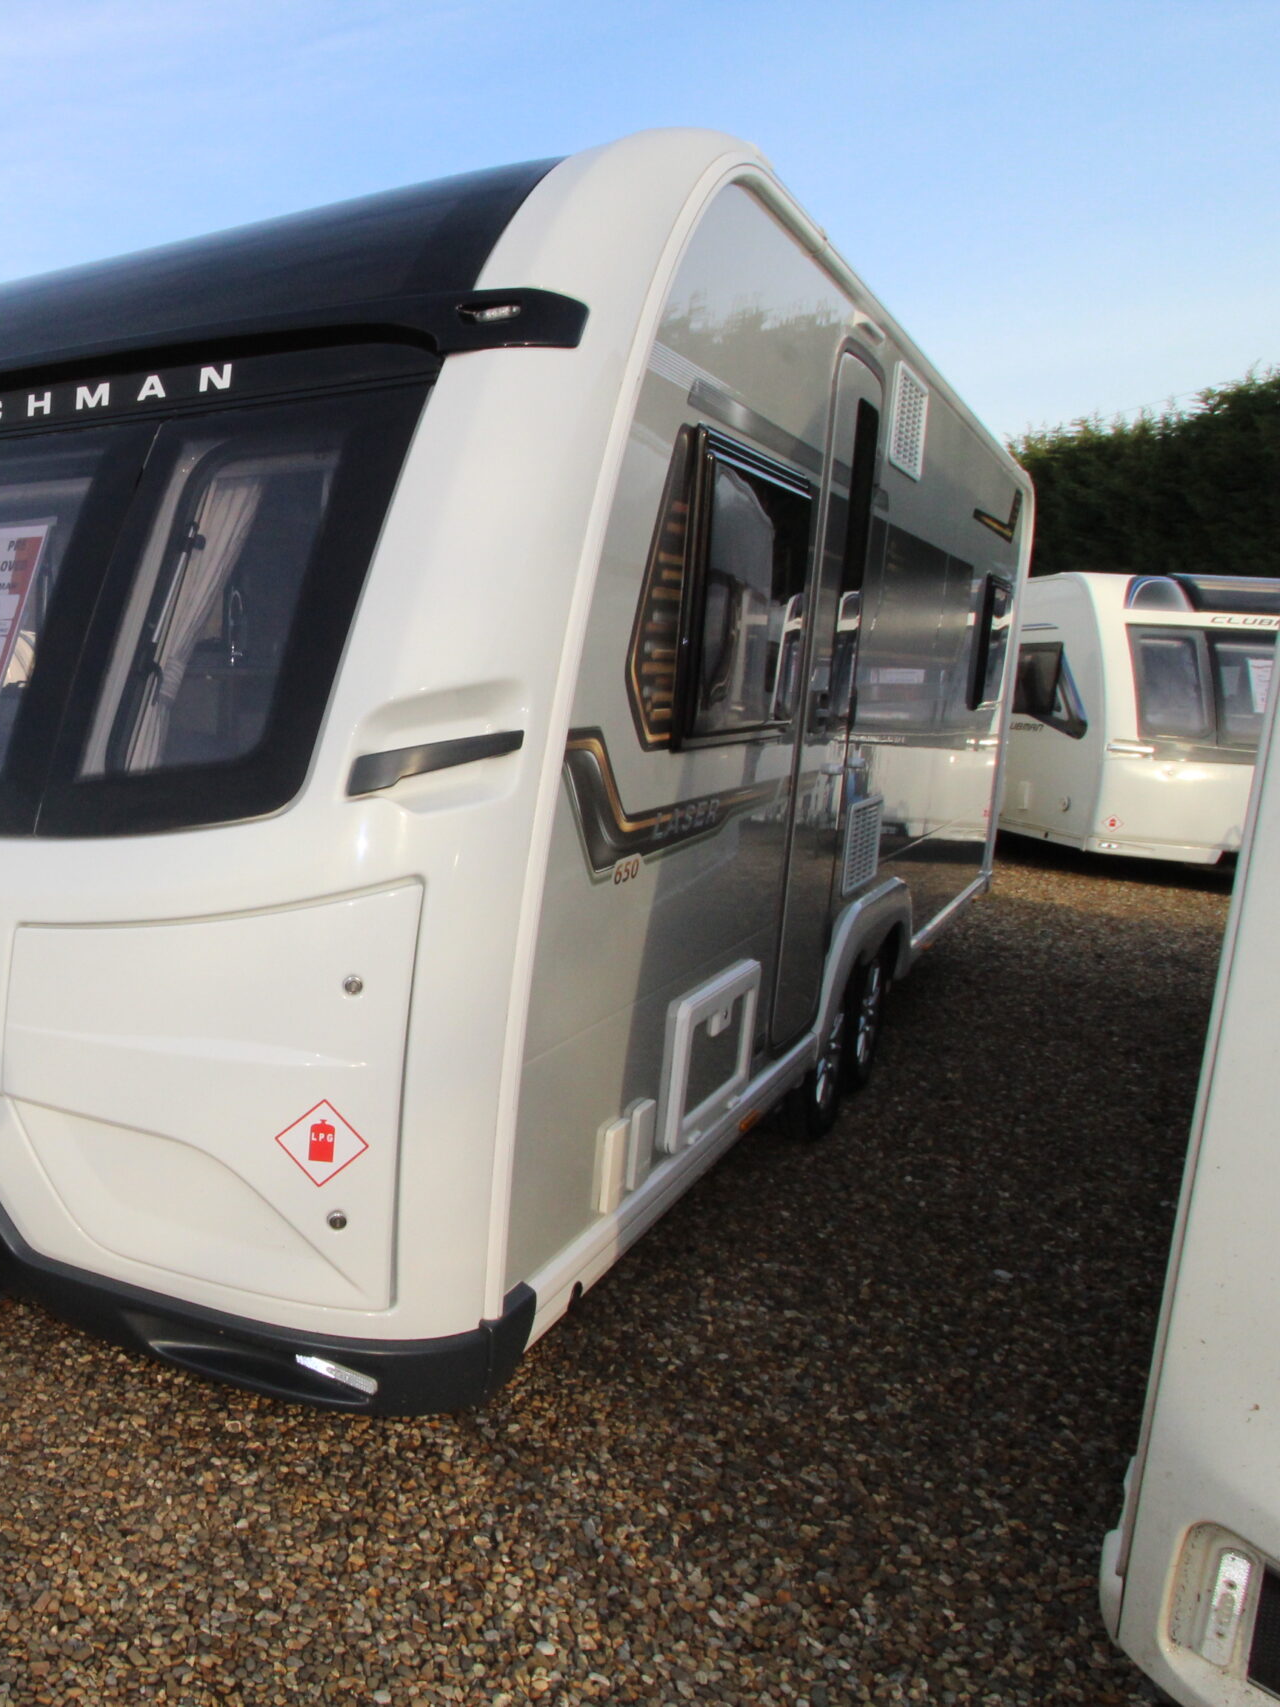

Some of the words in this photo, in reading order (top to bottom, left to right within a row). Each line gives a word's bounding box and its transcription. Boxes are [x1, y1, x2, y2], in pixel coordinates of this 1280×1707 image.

[652, 798, 720, 840] LASER
[614, 858, 640, 886] 650
[311, 1132, 334, 1143] LPG
